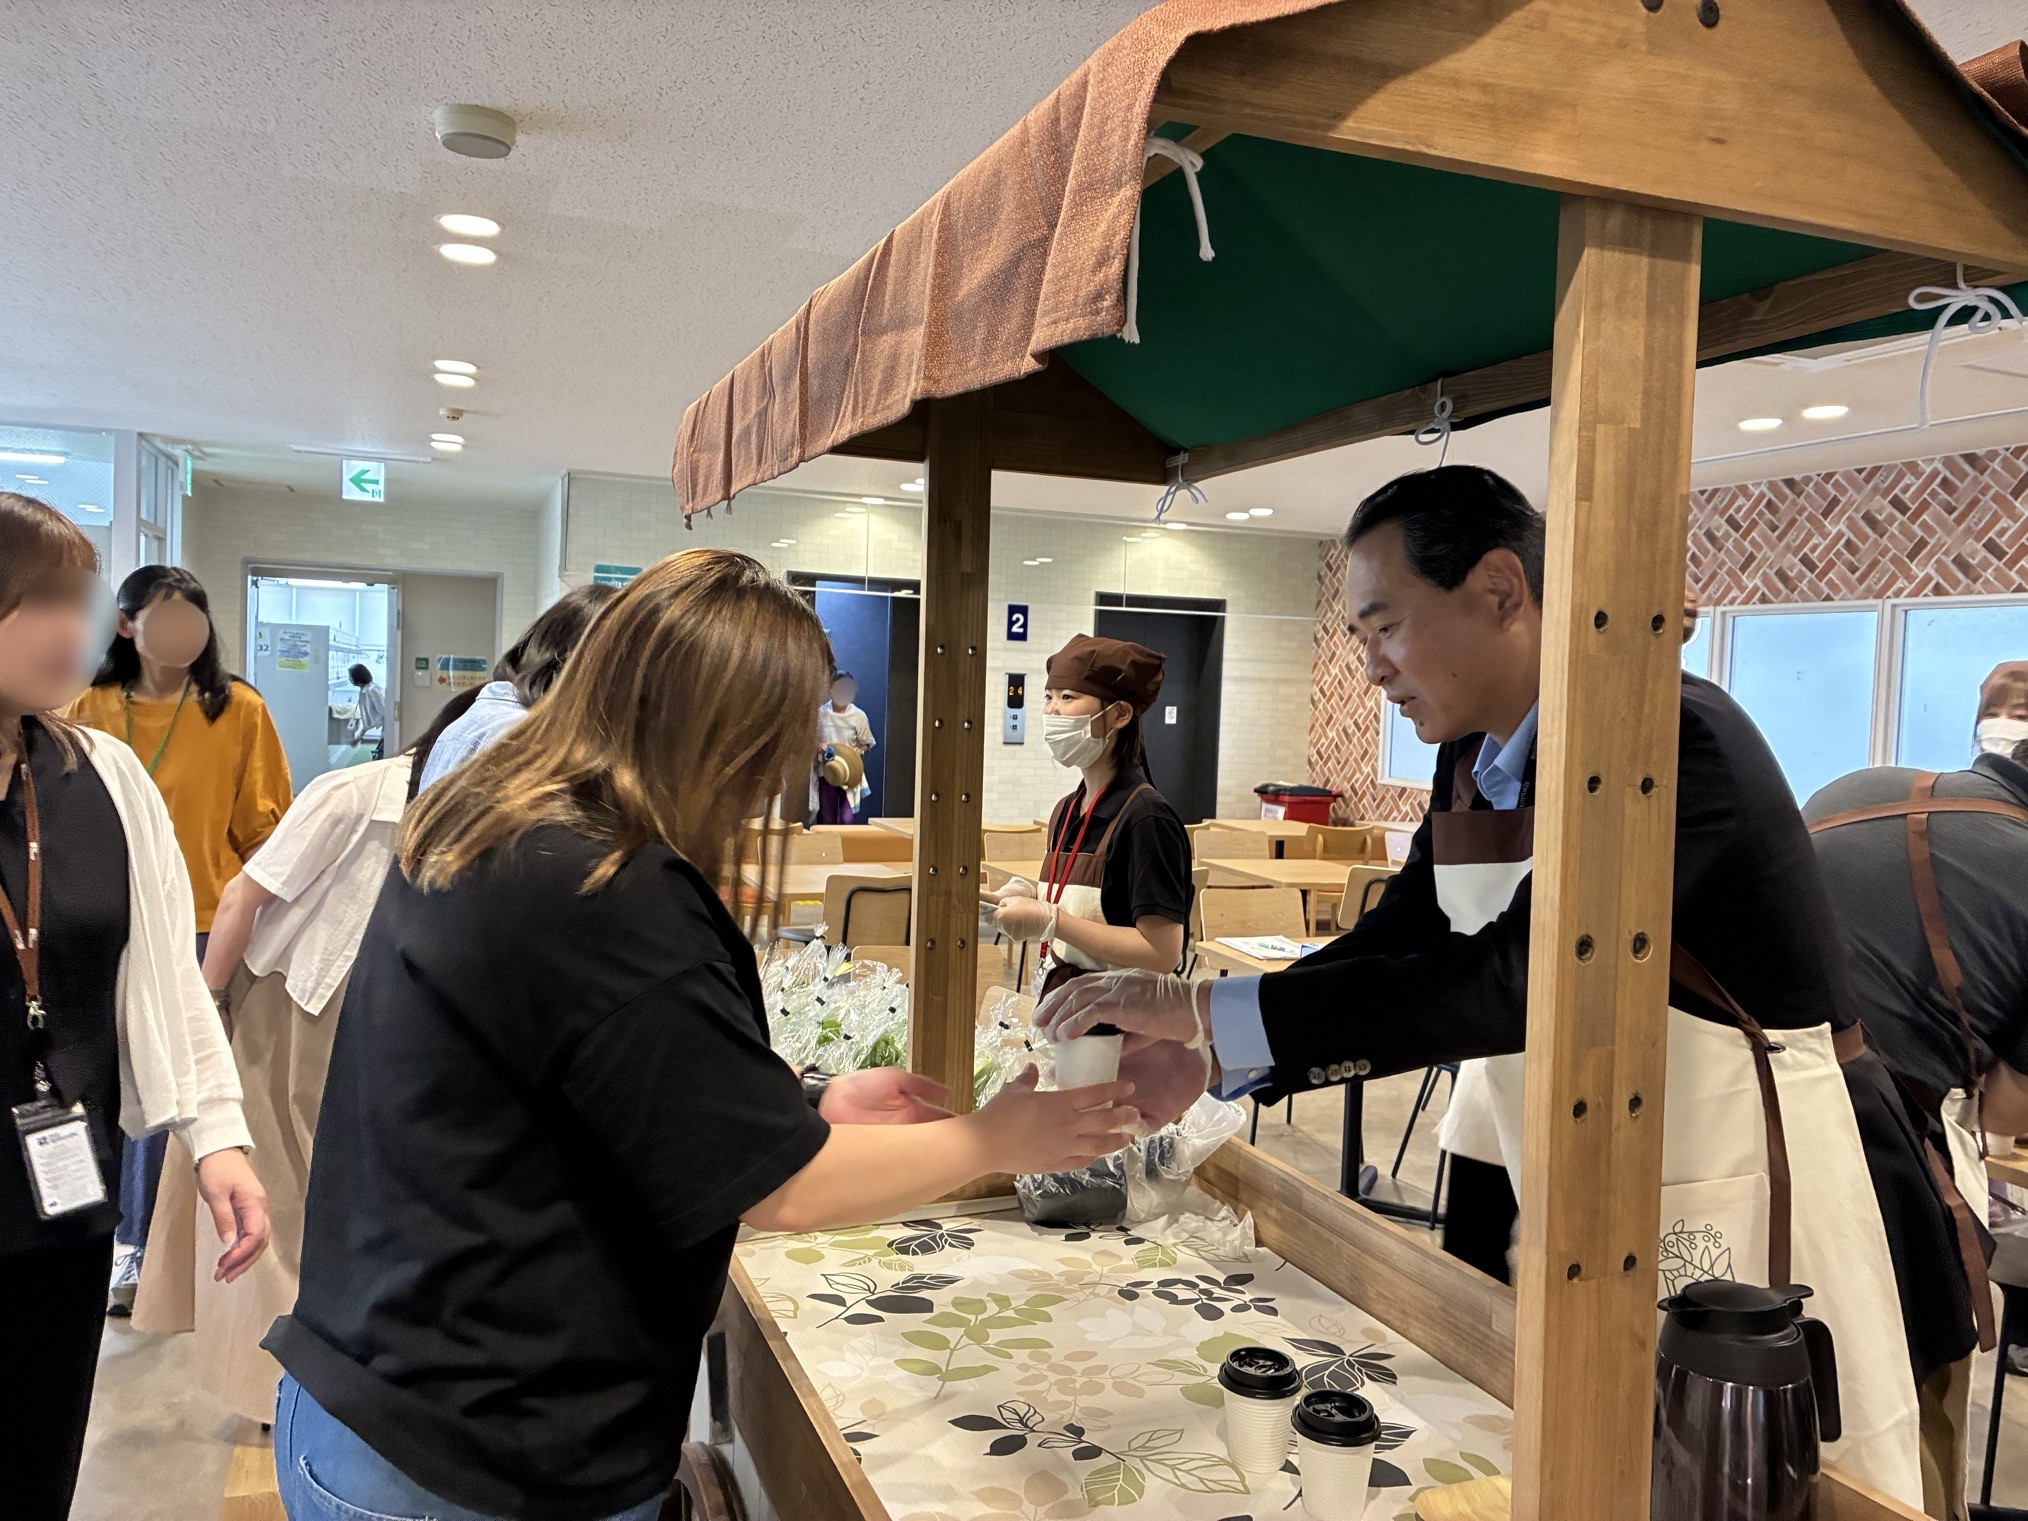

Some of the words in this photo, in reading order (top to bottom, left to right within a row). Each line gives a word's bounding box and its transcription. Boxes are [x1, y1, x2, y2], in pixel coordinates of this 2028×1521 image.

[1011, 613, 1024, 633] 2
[1009, 686, 1014, 696] 2
[1017, 686, 1023, 696] 4
